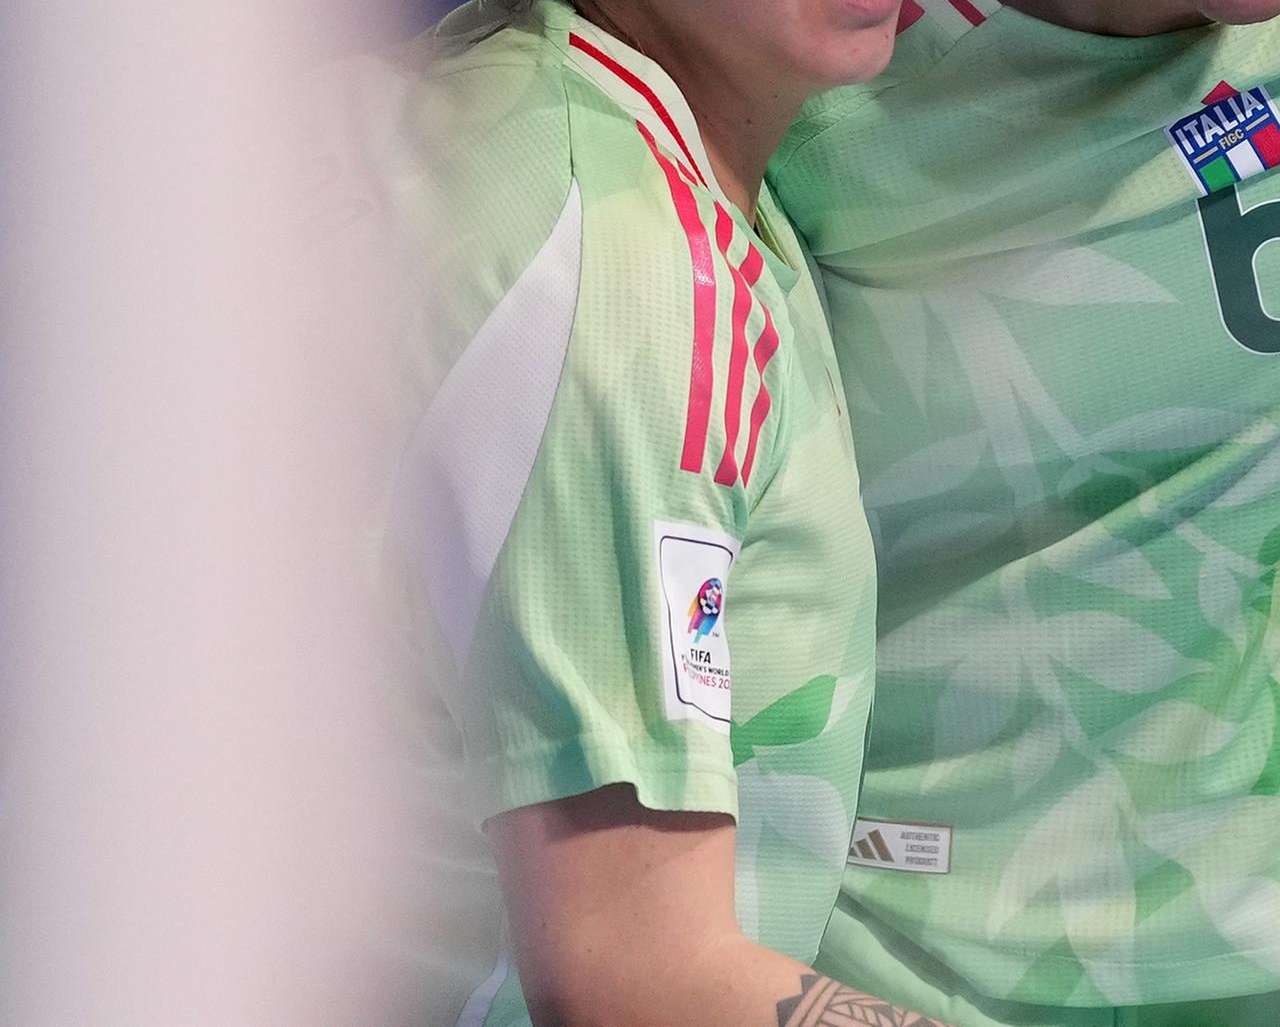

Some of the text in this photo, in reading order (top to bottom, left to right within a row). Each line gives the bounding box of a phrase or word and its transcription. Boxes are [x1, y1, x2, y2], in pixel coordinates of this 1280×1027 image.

[1174, 92, 1265, 156] ITALIA
[1218, 128, 1246, 151] FIGC
[690, 648, 711, 664] FIFA
